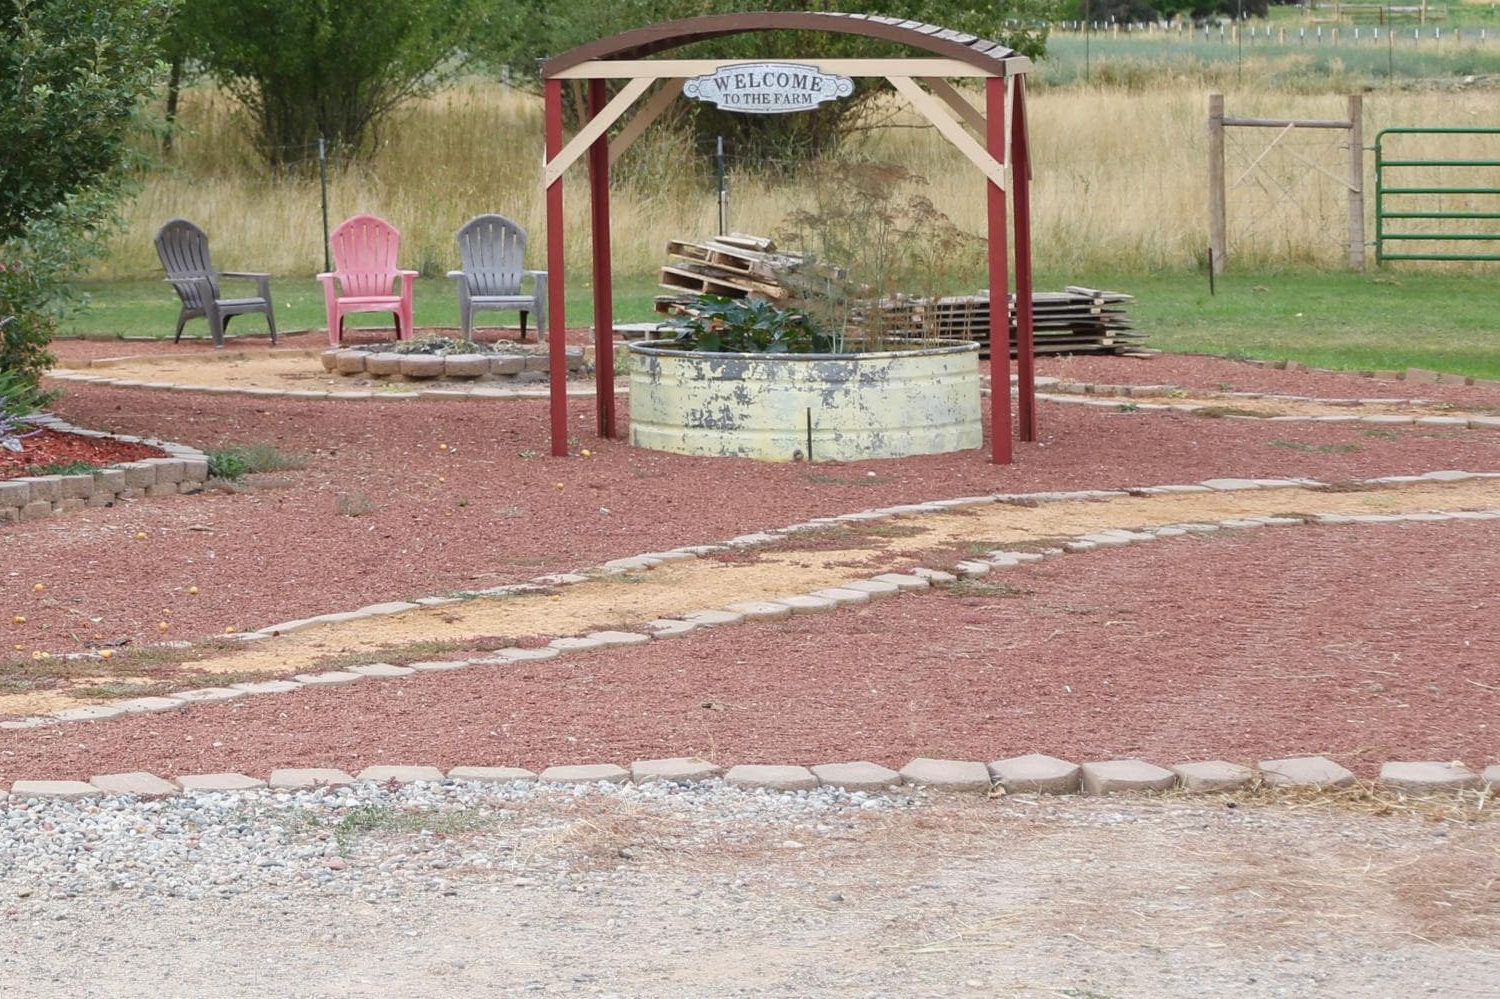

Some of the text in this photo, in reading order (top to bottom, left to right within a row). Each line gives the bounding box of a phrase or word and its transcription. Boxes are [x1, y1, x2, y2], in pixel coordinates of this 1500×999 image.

[713, 72, 823, 93] WELCOME
[723, 93, 813, 105] TO THE FARM
